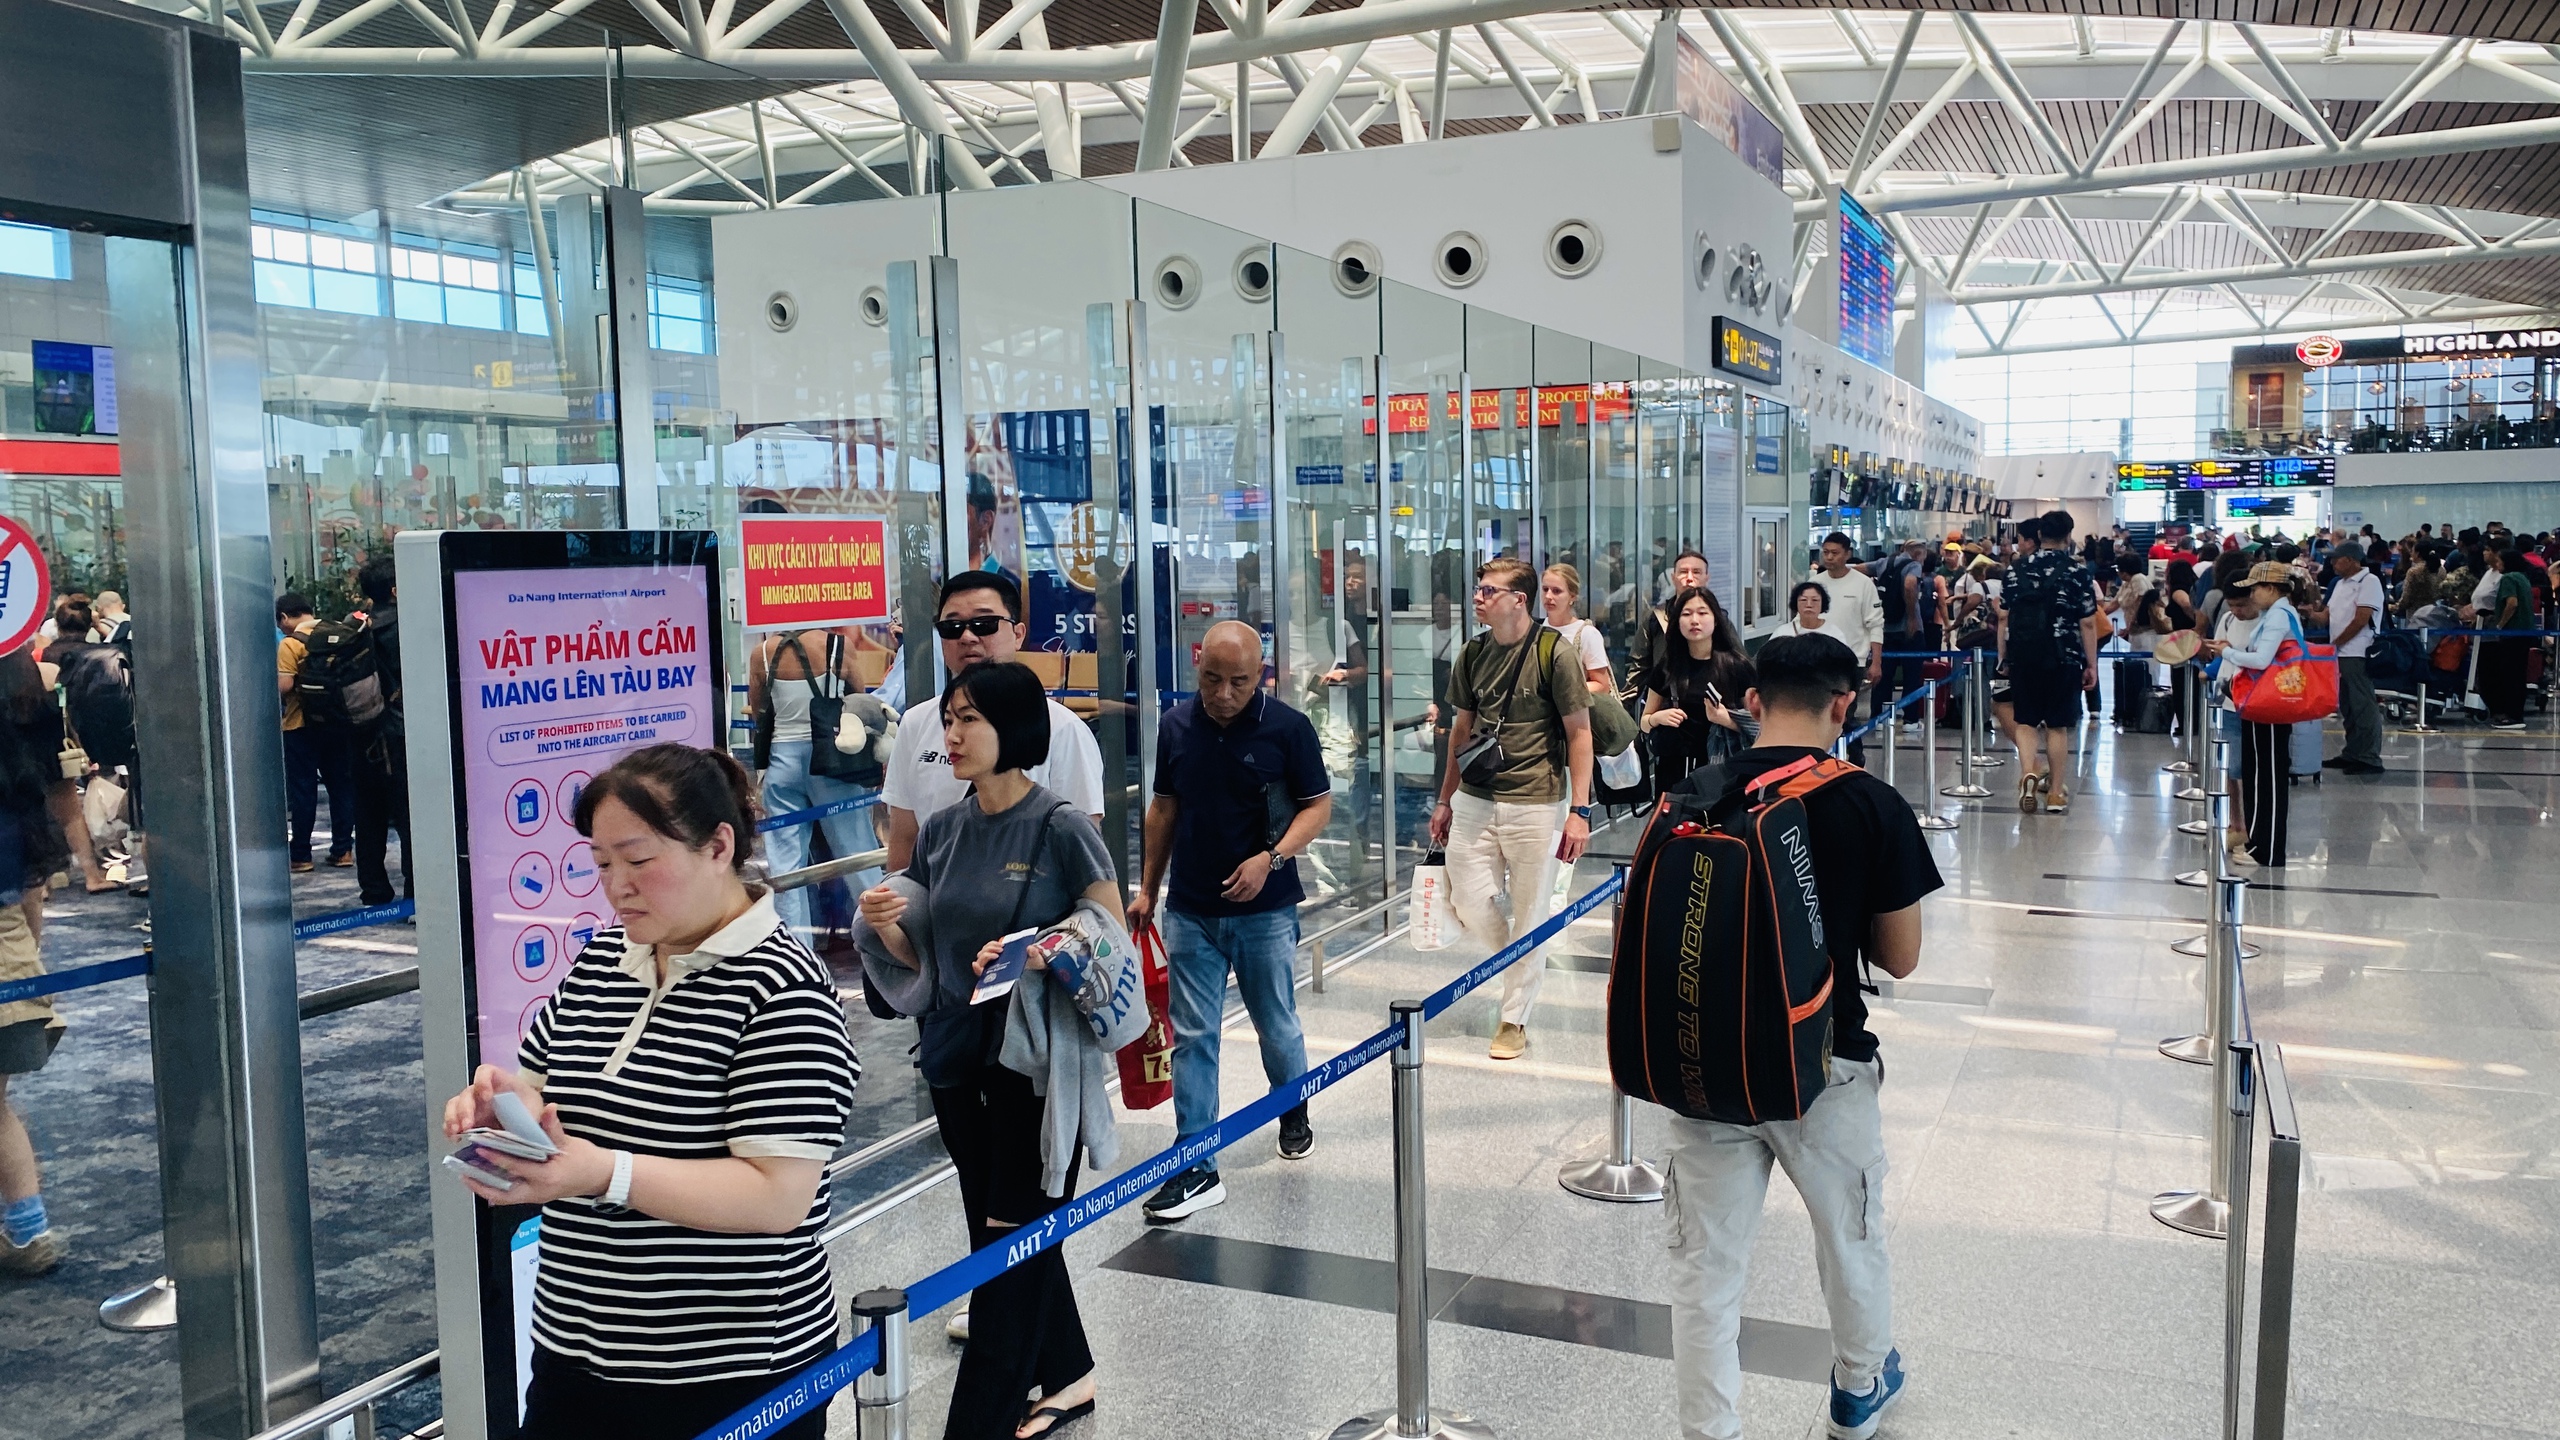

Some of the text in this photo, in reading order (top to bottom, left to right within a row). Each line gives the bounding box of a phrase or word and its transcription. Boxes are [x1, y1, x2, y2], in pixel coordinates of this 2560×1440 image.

[1740, 336, 1758, 366] 01-27
[2404, 331, 2560, 353] HIGHLAND
[1447, 395, 1498, 409] SYTEM
[748, 534, 881, 577] KHU VỰC CÁCH LY XUẤT NHẬP CẢNH
[508, 588, 666, 603] Da Nang International Airport
[761, 581, 873, 605] IMMIGRATION STERILE AREA
[1055, 613, 1136, 634] 5 STRS
[479, 618, 696, 677] VẬT PHẨM CẤM
[481, 665, 696, 709] MANG LÊN TÀU BAY
[499, 710, 687, 744] LIST OF PROHIBITED ITEMS TO BE CARRIED
[537, 729, 656, 754] INTO THE AIRCRAFT CABIN
[1005, 862, 1031, 871] KODA
[363, 905, 400, 920] Terminal
[1678, 851, 1713, 1008] STRONG
[1452, 982, 1466, 1002] AHT
[1492, 947, 1517, 973] International
[1517, 935, 1533, 955] Terminal
[1109, 956, 1138, 1026] SILLY
[1677, 1010, 1701, 1060] TO
[1300, 1027, 1406, 1101] AHT Da Nang Internationa
[1006, 1127, 1221, 1267] AHT Da Nang International Terminal
